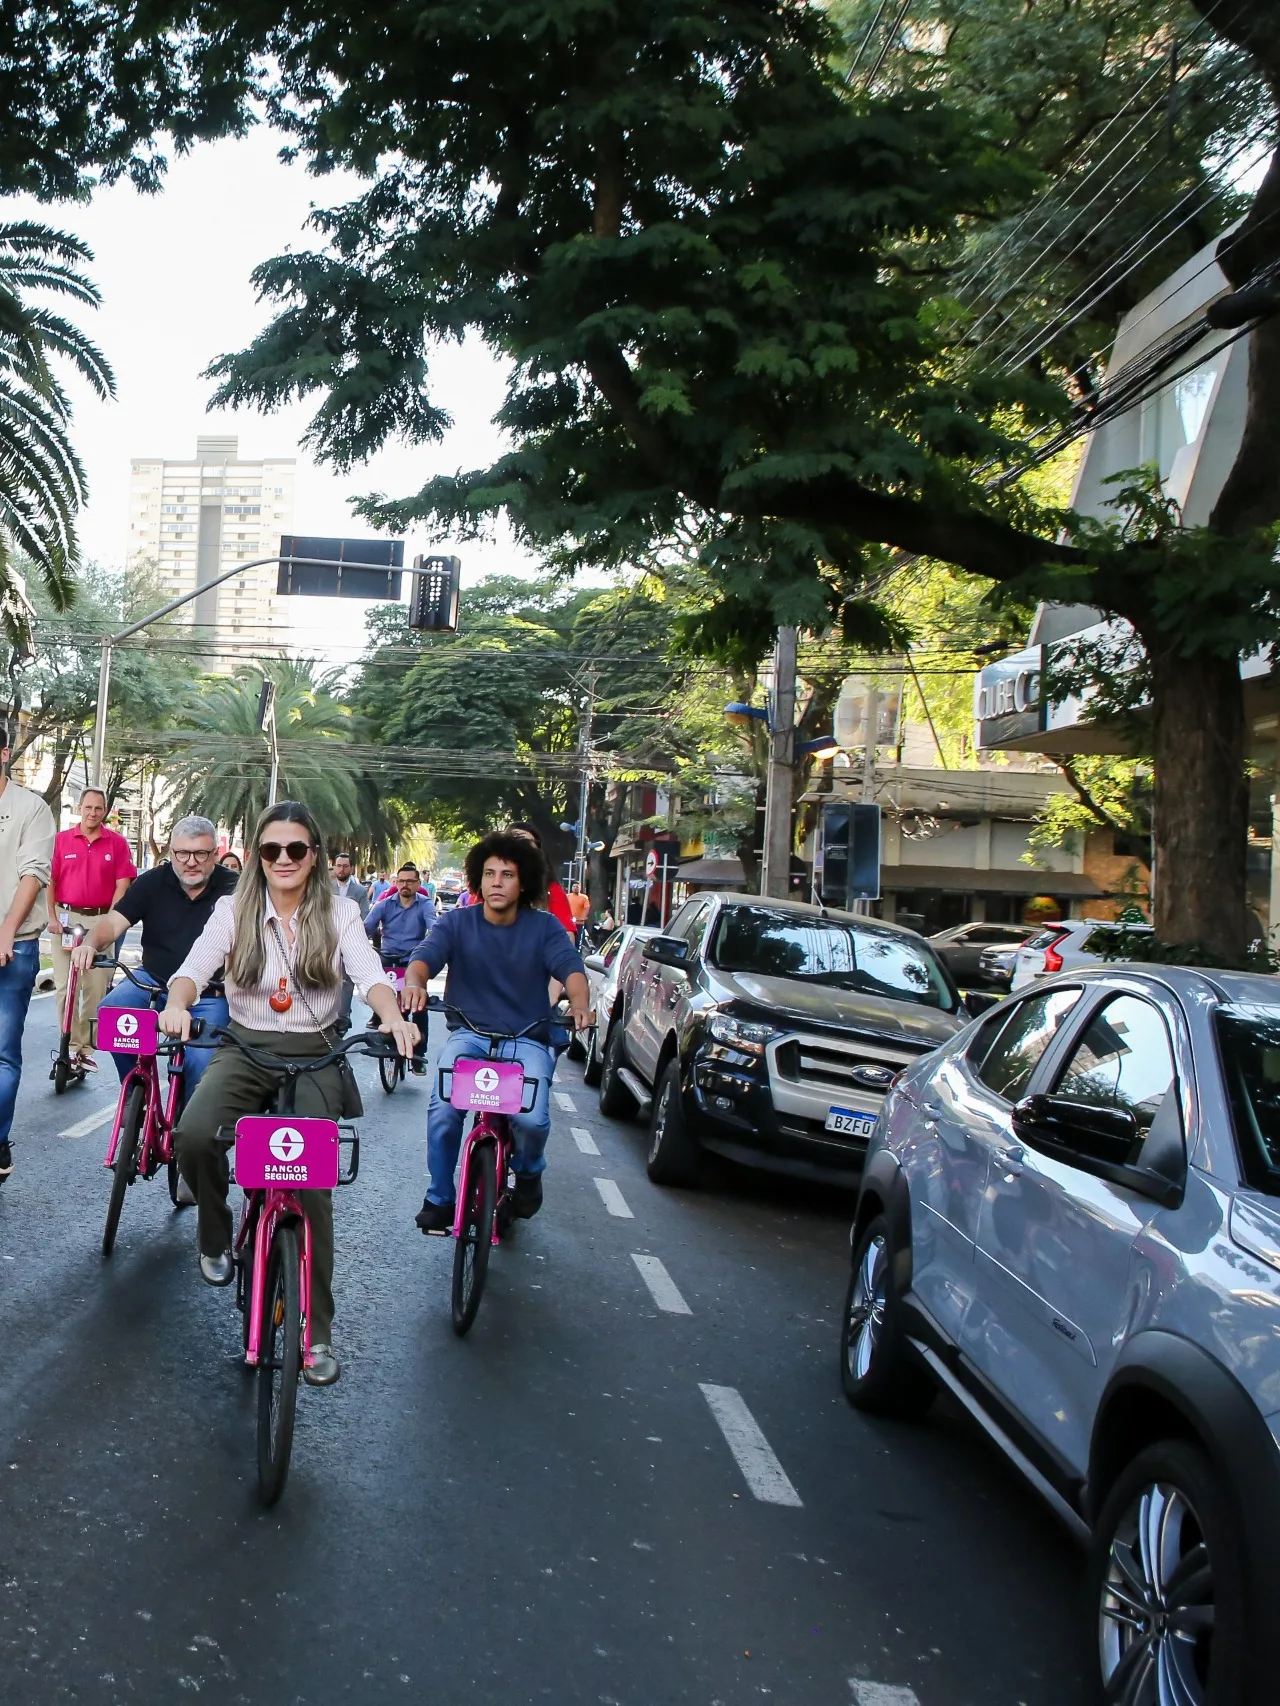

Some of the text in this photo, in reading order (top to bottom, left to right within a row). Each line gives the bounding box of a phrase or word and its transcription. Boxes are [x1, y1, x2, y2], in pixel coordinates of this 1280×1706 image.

[470, 1093, 500, 1101] SANCOR
[469, 1099, 500, 1107] SEGUROS
[264, 1164, 308, 1174] SANCOR
[264, 1172, 308, 1181] SEGUROS
